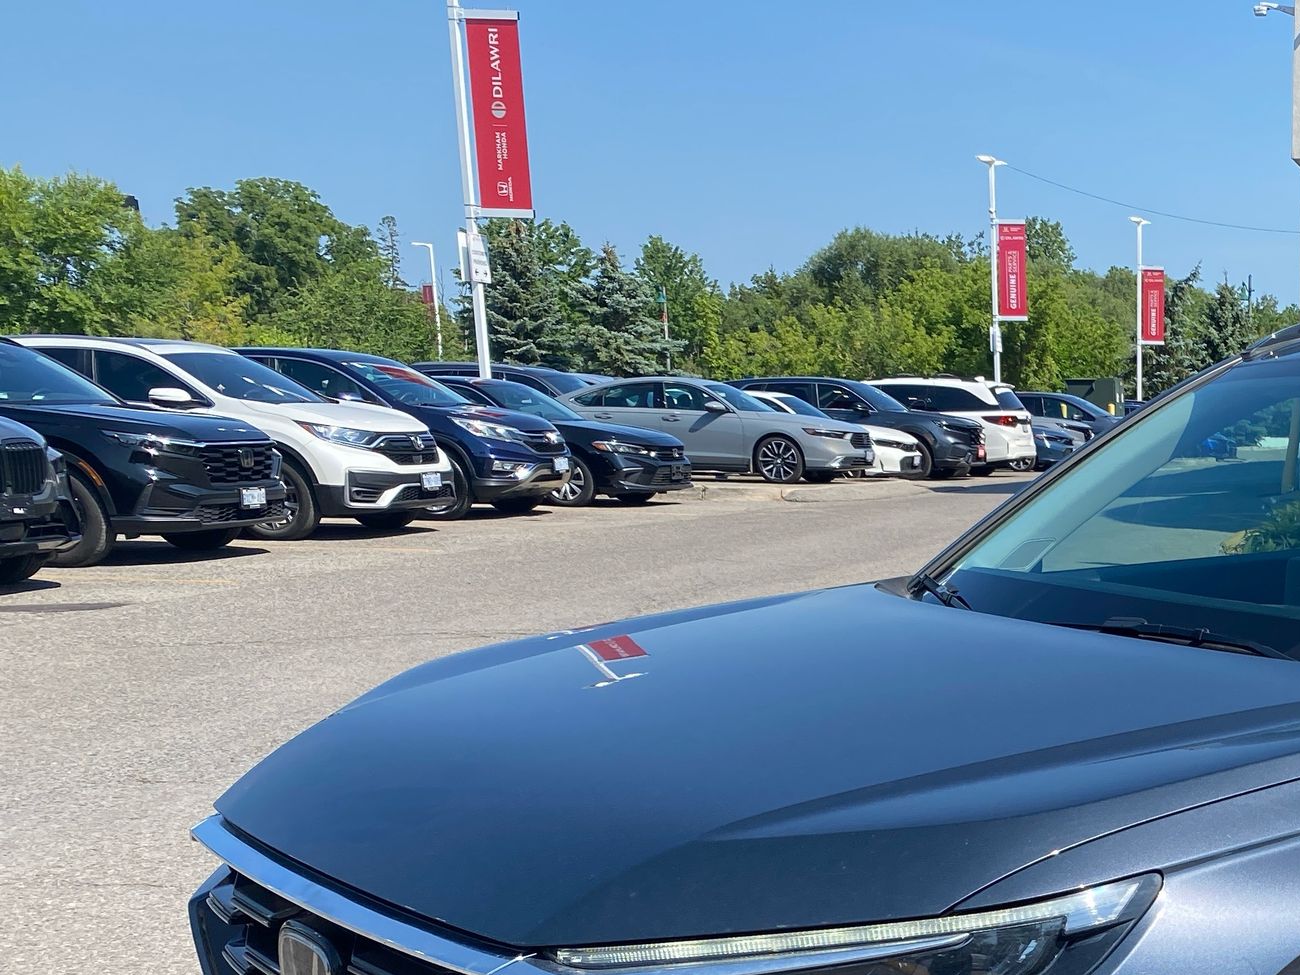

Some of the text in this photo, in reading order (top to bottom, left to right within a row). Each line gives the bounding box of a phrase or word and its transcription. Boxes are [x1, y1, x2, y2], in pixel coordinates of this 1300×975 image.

[487, 27, 503, 99] DILAWRI
[495, 131, 504, 171] MARKHAM
[1009, 273, 1017, 310] GENUINE
